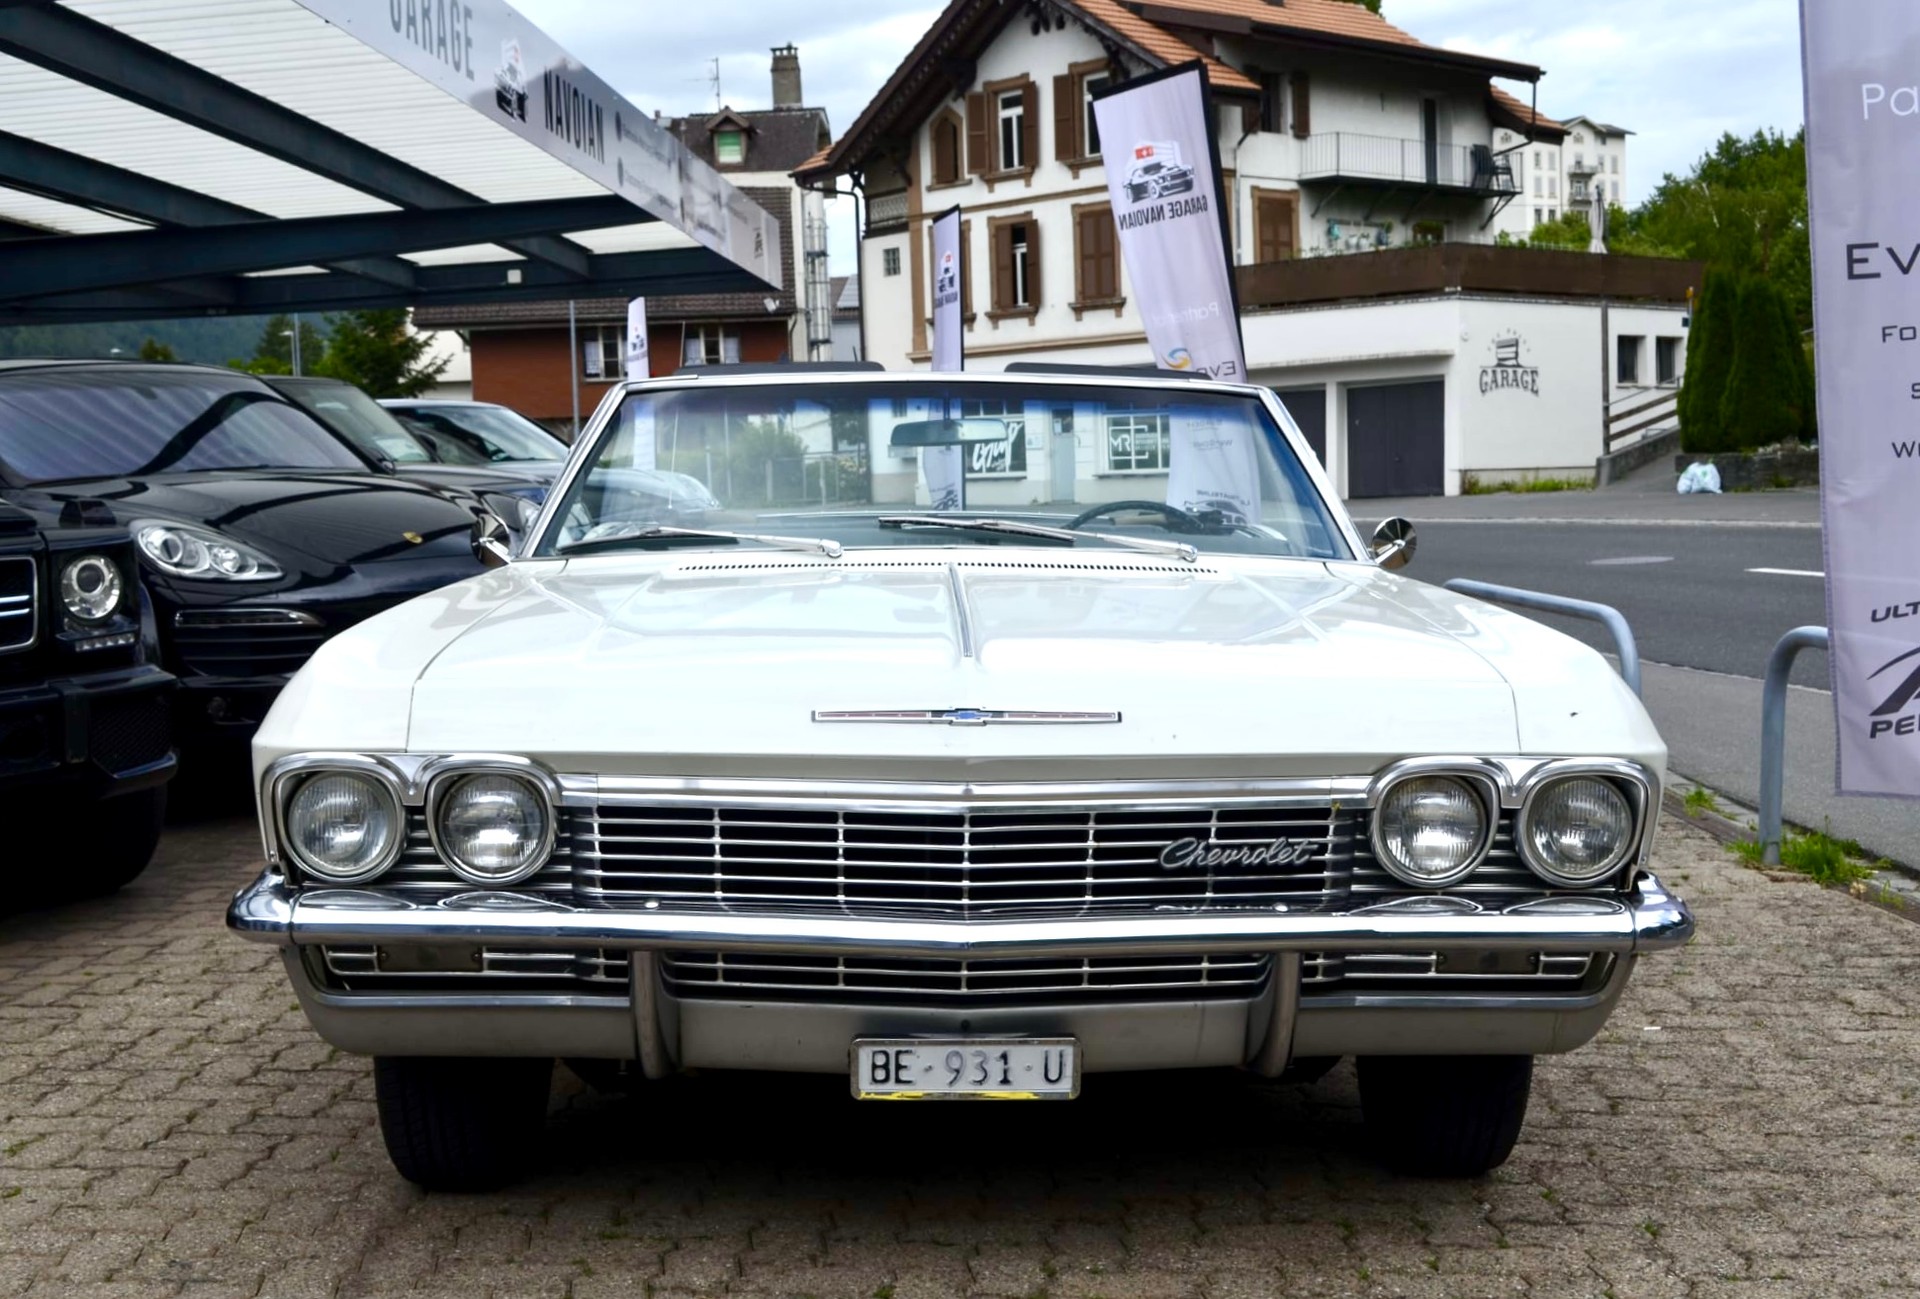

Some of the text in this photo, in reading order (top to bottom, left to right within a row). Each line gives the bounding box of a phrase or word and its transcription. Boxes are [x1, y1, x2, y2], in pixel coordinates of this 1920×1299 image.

[544, 66, 604, 164] NAVOIAN
[1479, 369, 1540, 397] GARAGE
[1160, 836, 1319, 870] Chevrolet
[870, 1049, 1065, 1086] BE 931 U
